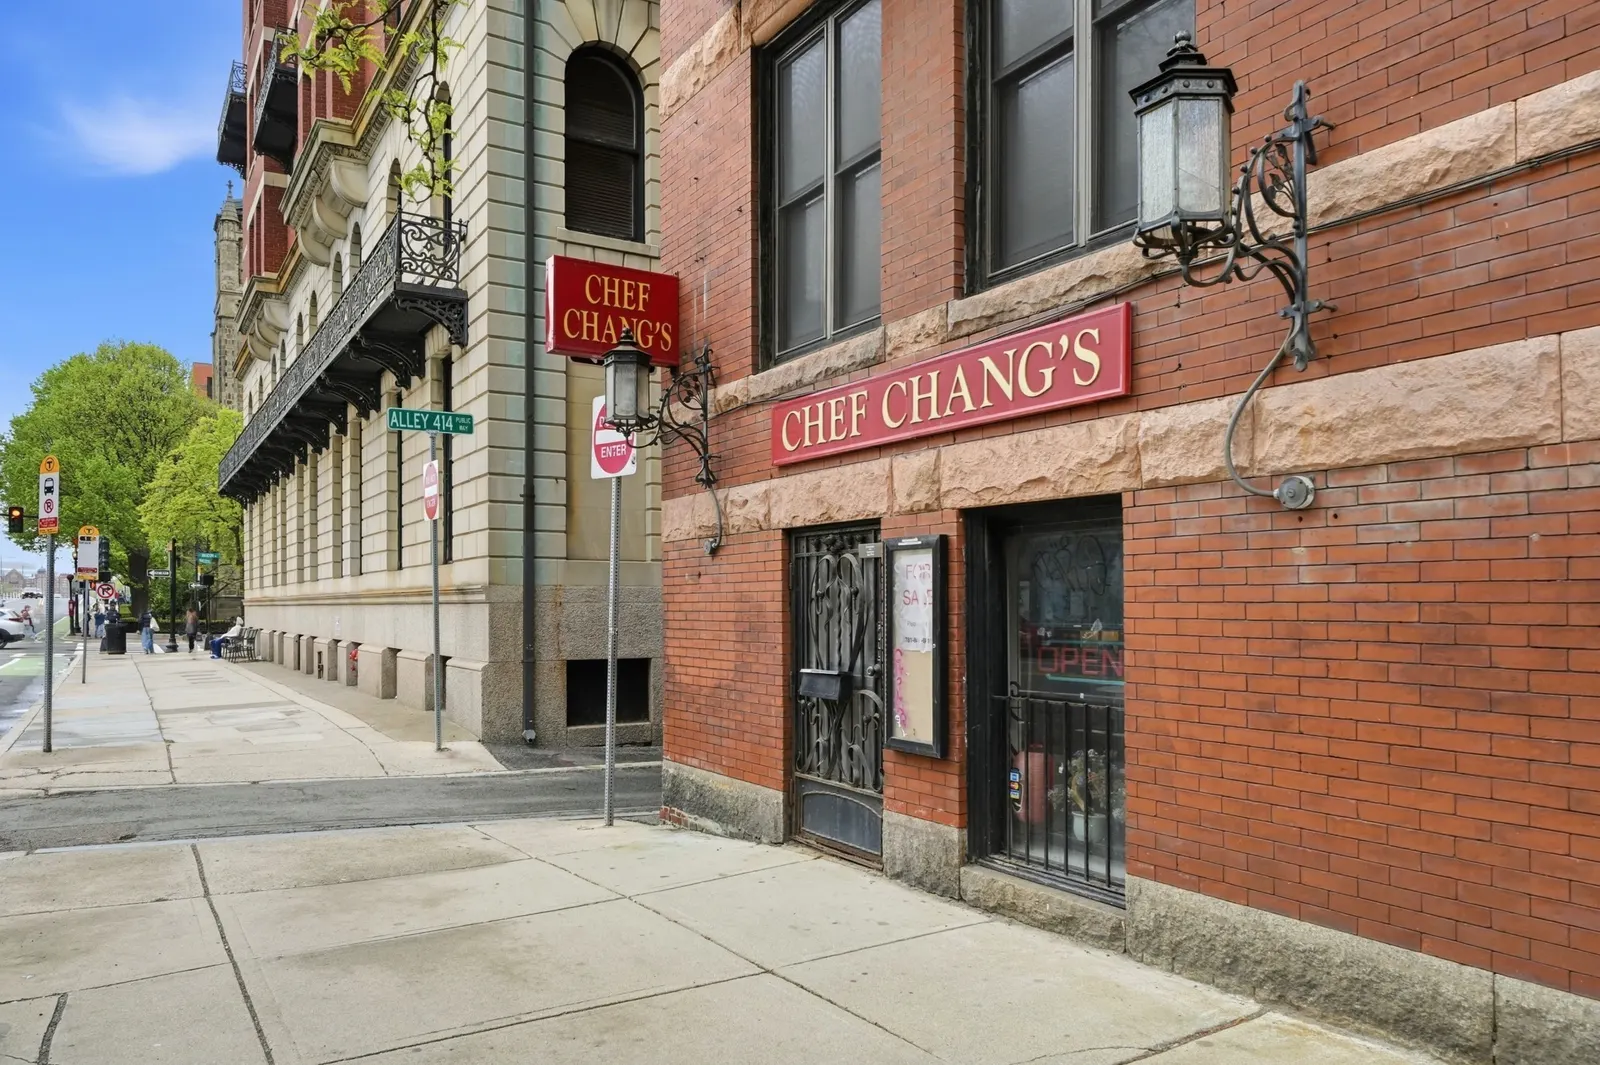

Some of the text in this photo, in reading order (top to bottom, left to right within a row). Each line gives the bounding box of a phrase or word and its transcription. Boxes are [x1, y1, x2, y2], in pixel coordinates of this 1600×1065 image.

[585, 274, 651, 312] CHEF
[563, 308, 672, 352] CHANG'S
[781, 327, 1101, 452] CHEF CHANG'S
[390, 411, 453, 431] ALLEY 414
[456, 416, 471, 424] PUBLIC
[601, 444, 627, 458] ENTER
[1037, 646, 1124, 677] OPEN
